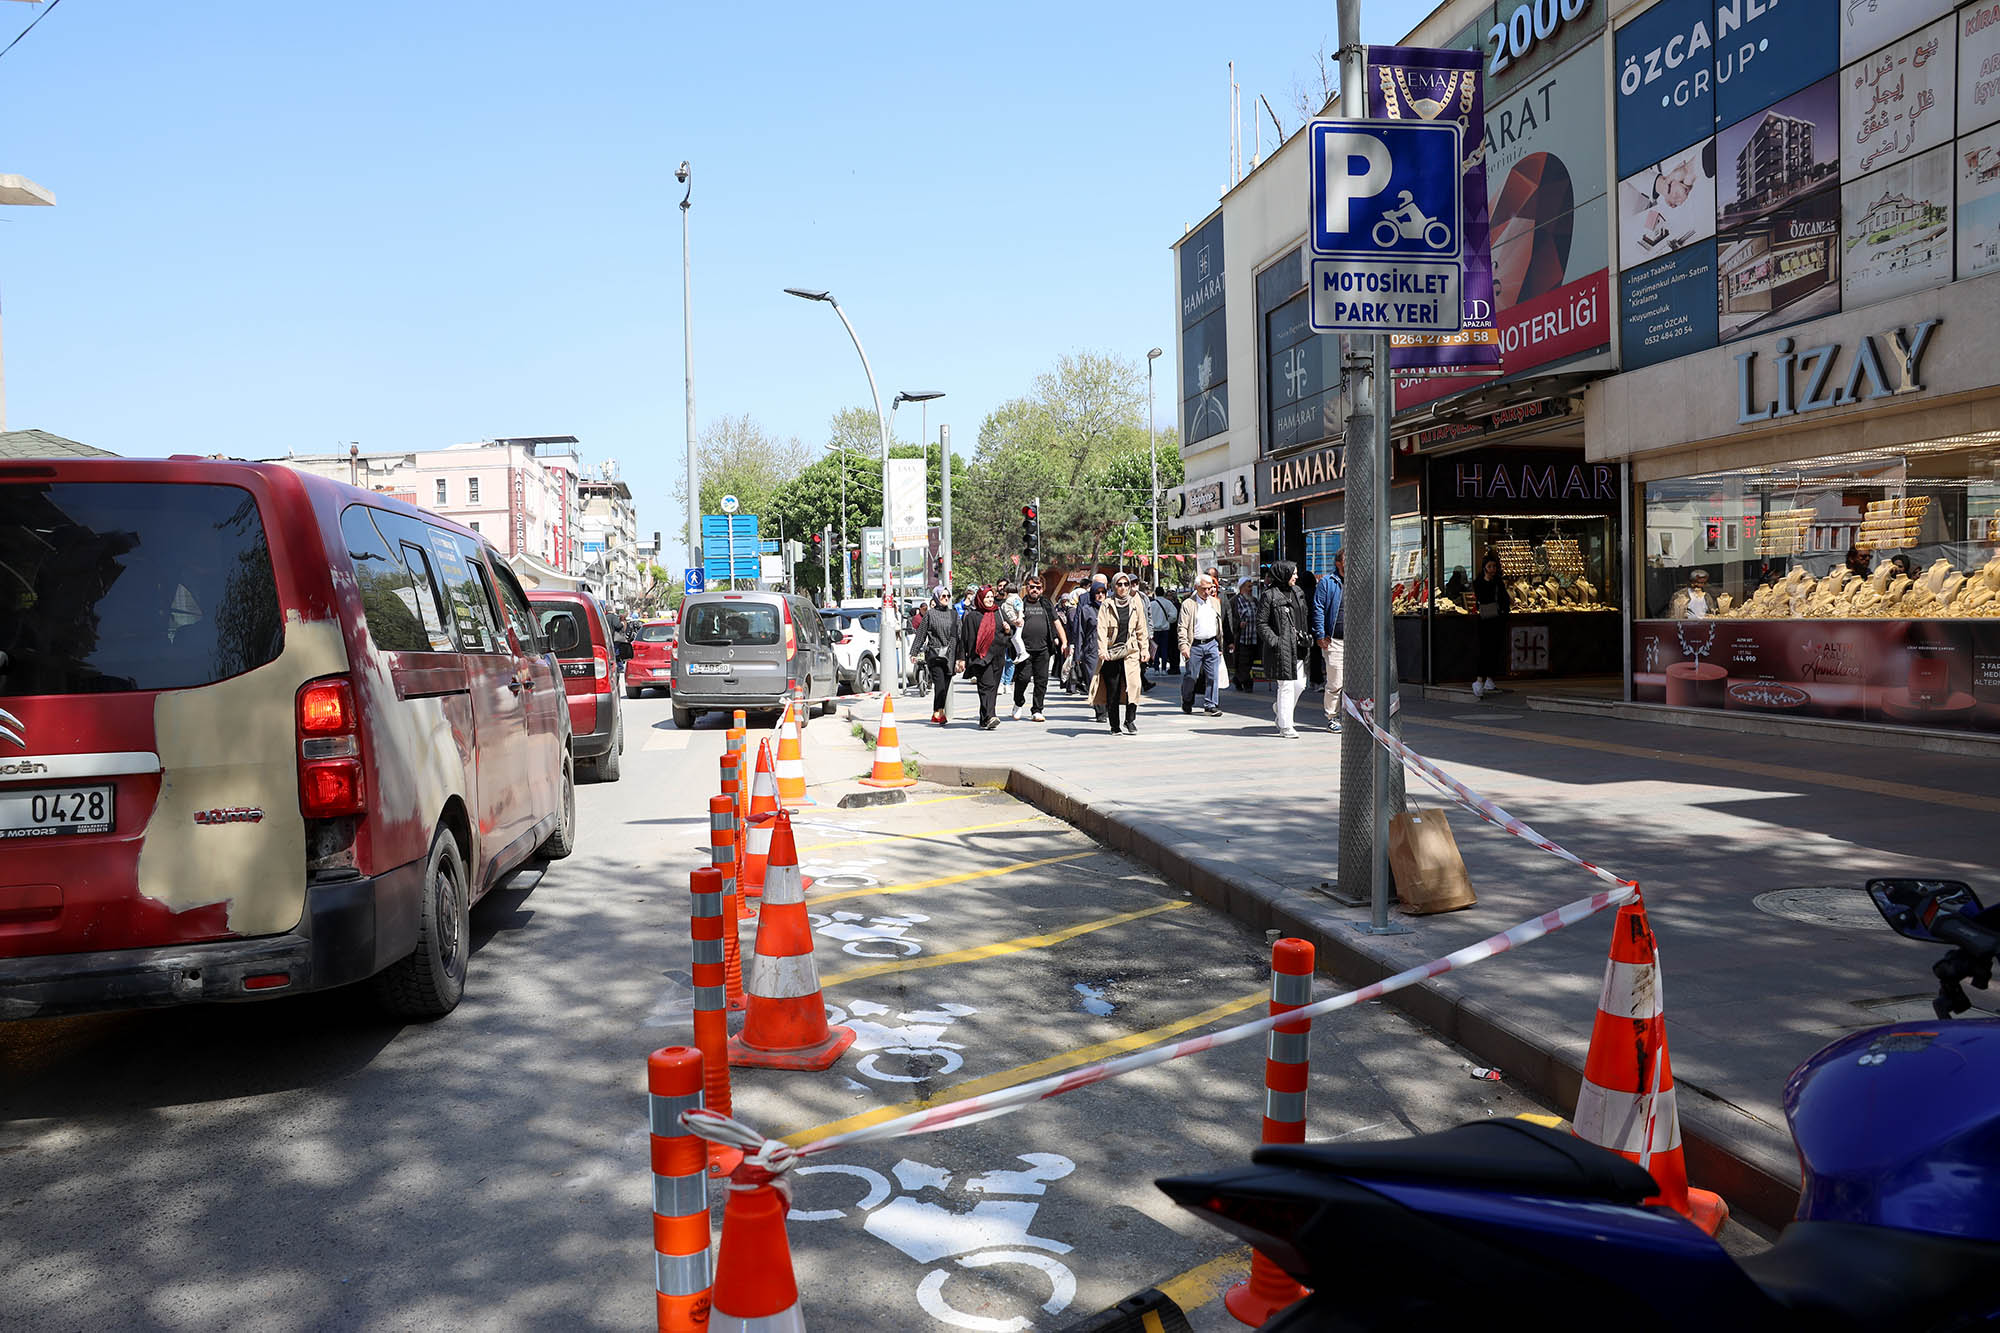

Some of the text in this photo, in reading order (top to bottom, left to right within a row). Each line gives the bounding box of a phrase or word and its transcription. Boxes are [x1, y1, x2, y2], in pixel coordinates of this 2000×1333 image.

[1620, 0, 1778, 96] ÖZCANL
[1408, 72, 1447, 88] EMA
[1673, 42, 1756, 107] GRUP
[1325, 132, 1393, 233] P
[1184, 271, 1225, 316] HAMARAT
[1323, 268, 1449, 294] MOTOSİKLET
[1335, 299, 1439, 323] PARK YERİ
[1391, 333, 1422, 344] 0264
[1473, 331, 1489, 342] 58
[1734, 319, 1943, 425] LİZAY
[1277, 406, 1317, 431] HAMARAT
[32, 792, 104, 823] 0428
[8, 828, 57, 838] MOTORS
